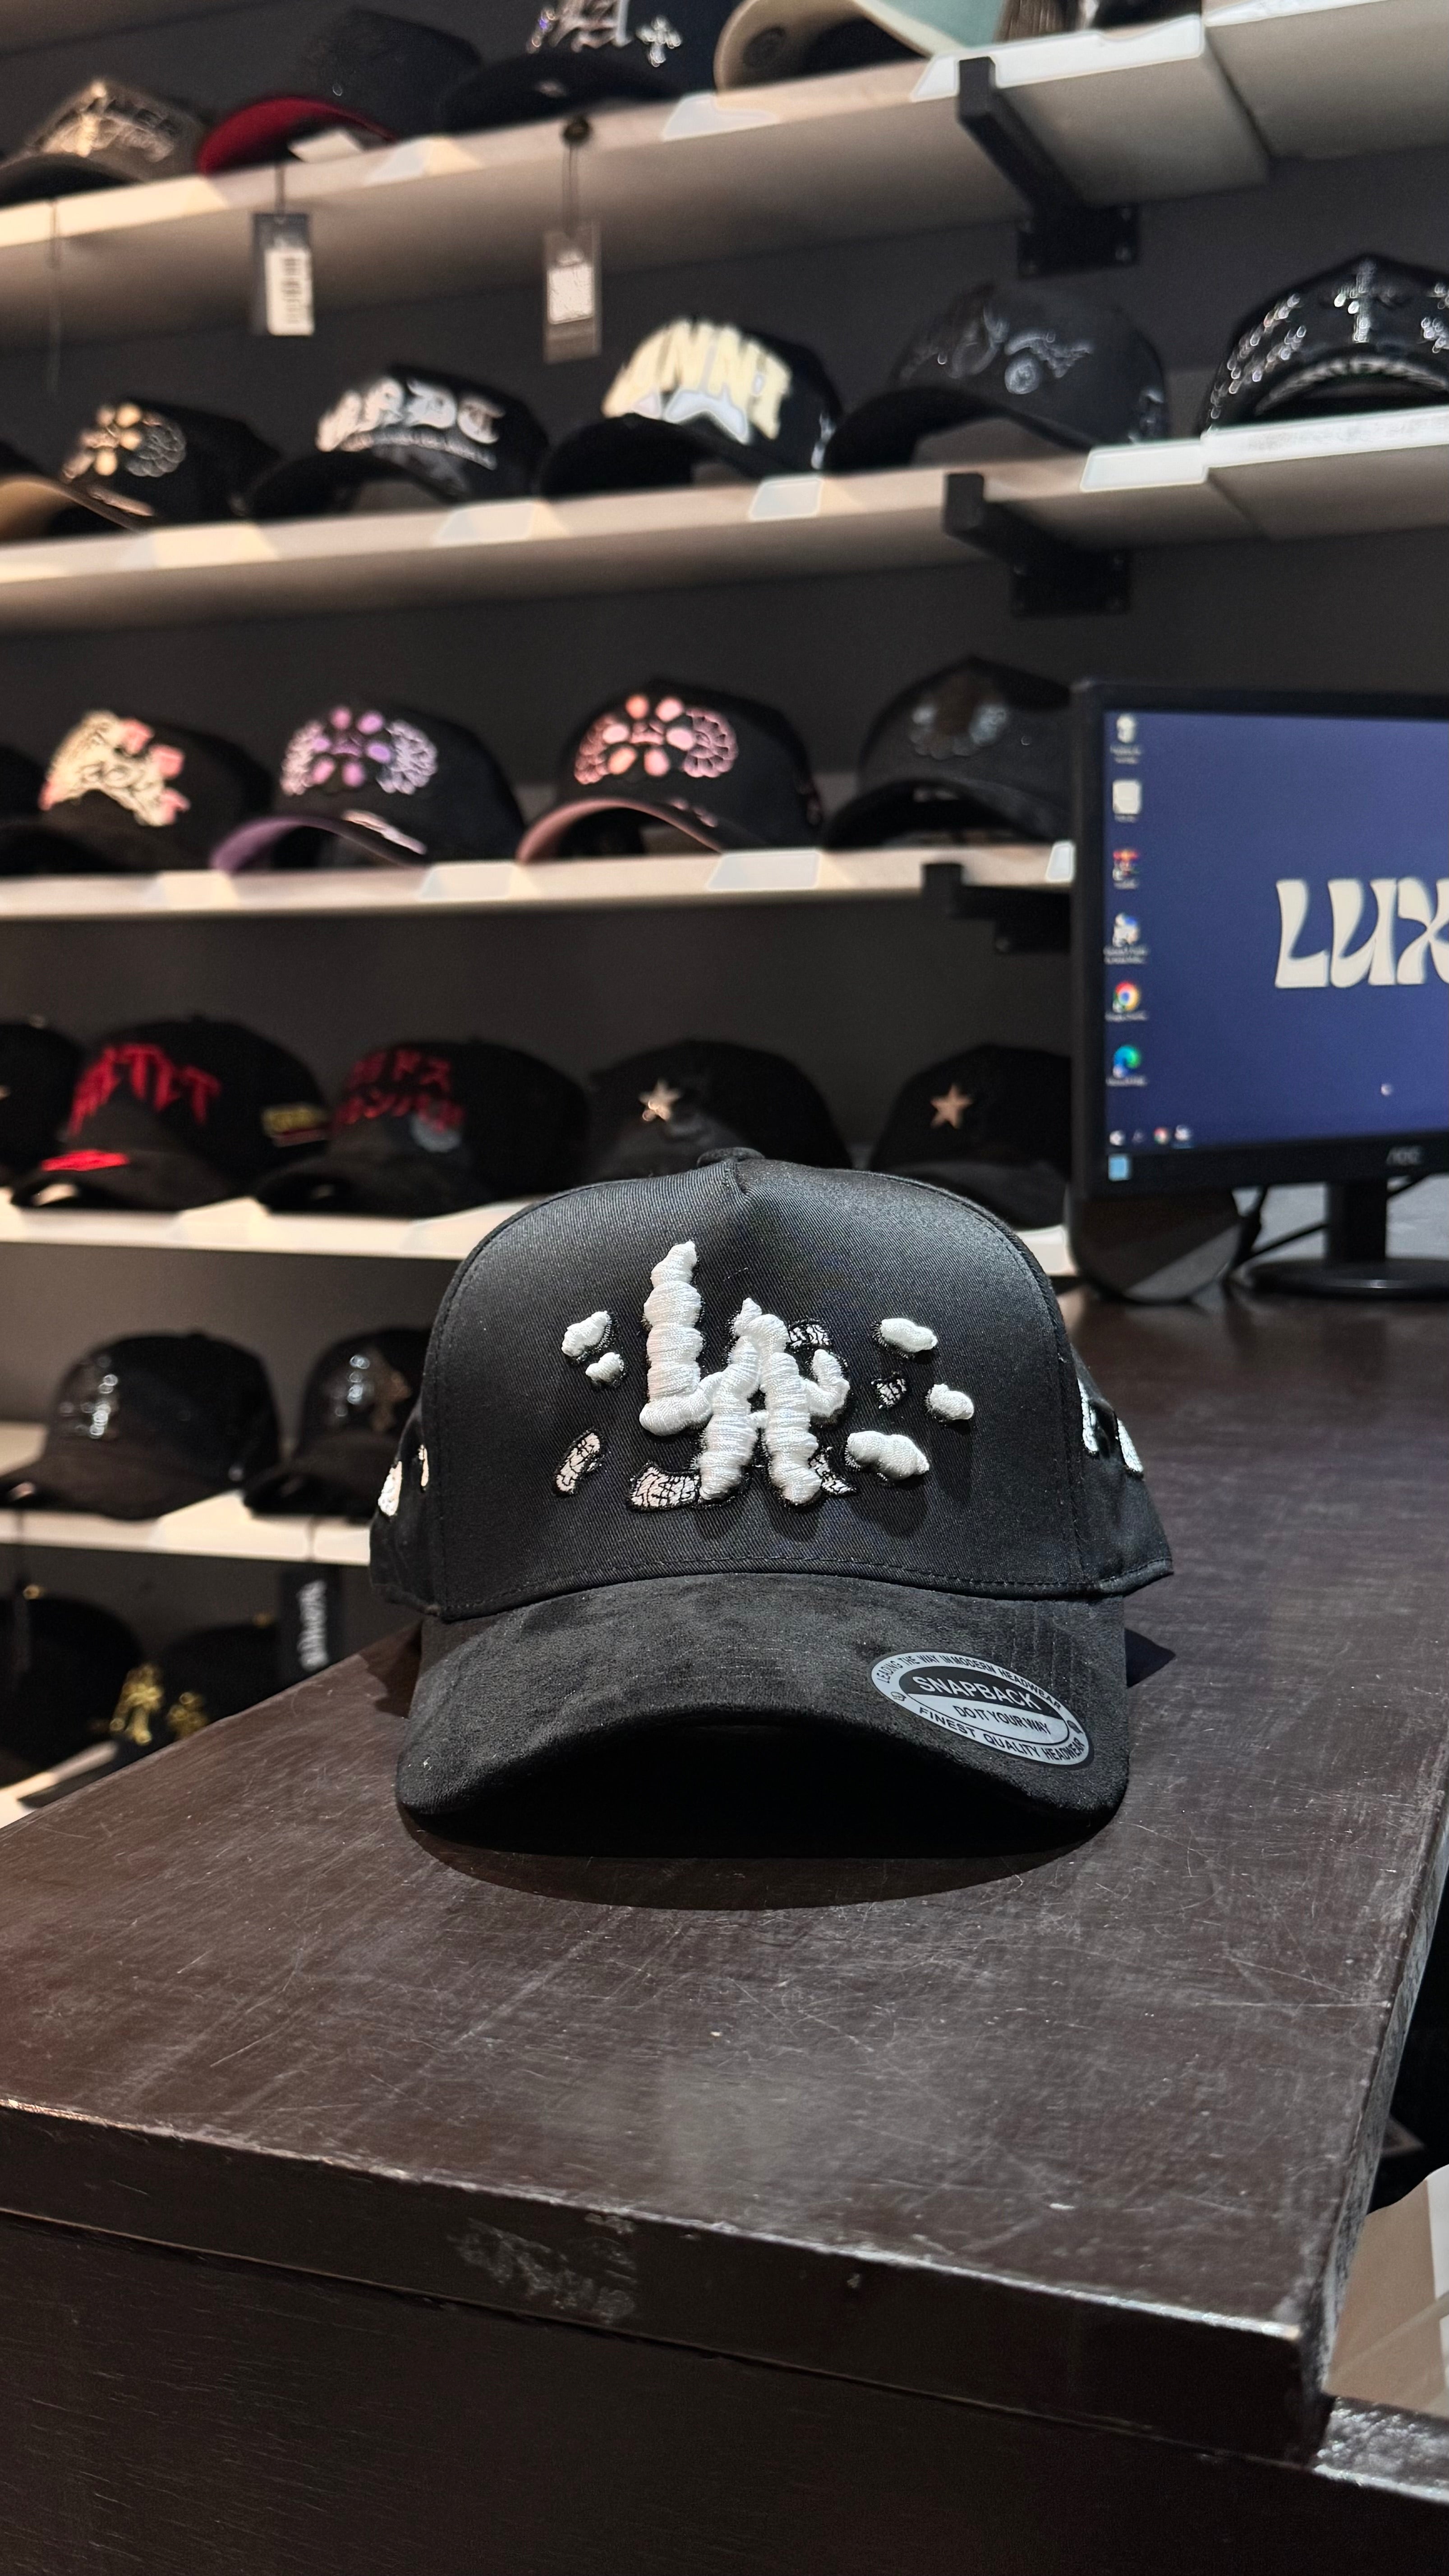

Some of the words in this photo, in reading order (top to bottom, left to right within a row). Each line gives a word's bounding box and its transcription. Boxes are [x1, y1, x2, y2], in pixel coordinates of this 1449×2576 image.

[876, 1660, 904, 1684] LEADING
[897, 1656, 920, 1666] THE
[916, 1654, 940, 1663] WAY
[939, 1655, 953, 1664] IN
[951, 1656, 997, 1674] MODERN
[998, 1668, 1062, 1711] HEADWEAR
[912, 1676, 1042, 1711] SNAPBACK
[919, 1707, 976, 1738] FINEST
[983, 1733, 1041, 1757] QUALITY
[1041, 1737, 1086, 1761] HEADWEAR
[952, 1705, 977, 1719] DO
[974, 1708, 989, 1721] IT
[987, 1710, 1028, 1729] YOUR
[1022, 1717, 1051, 1735] WAY
